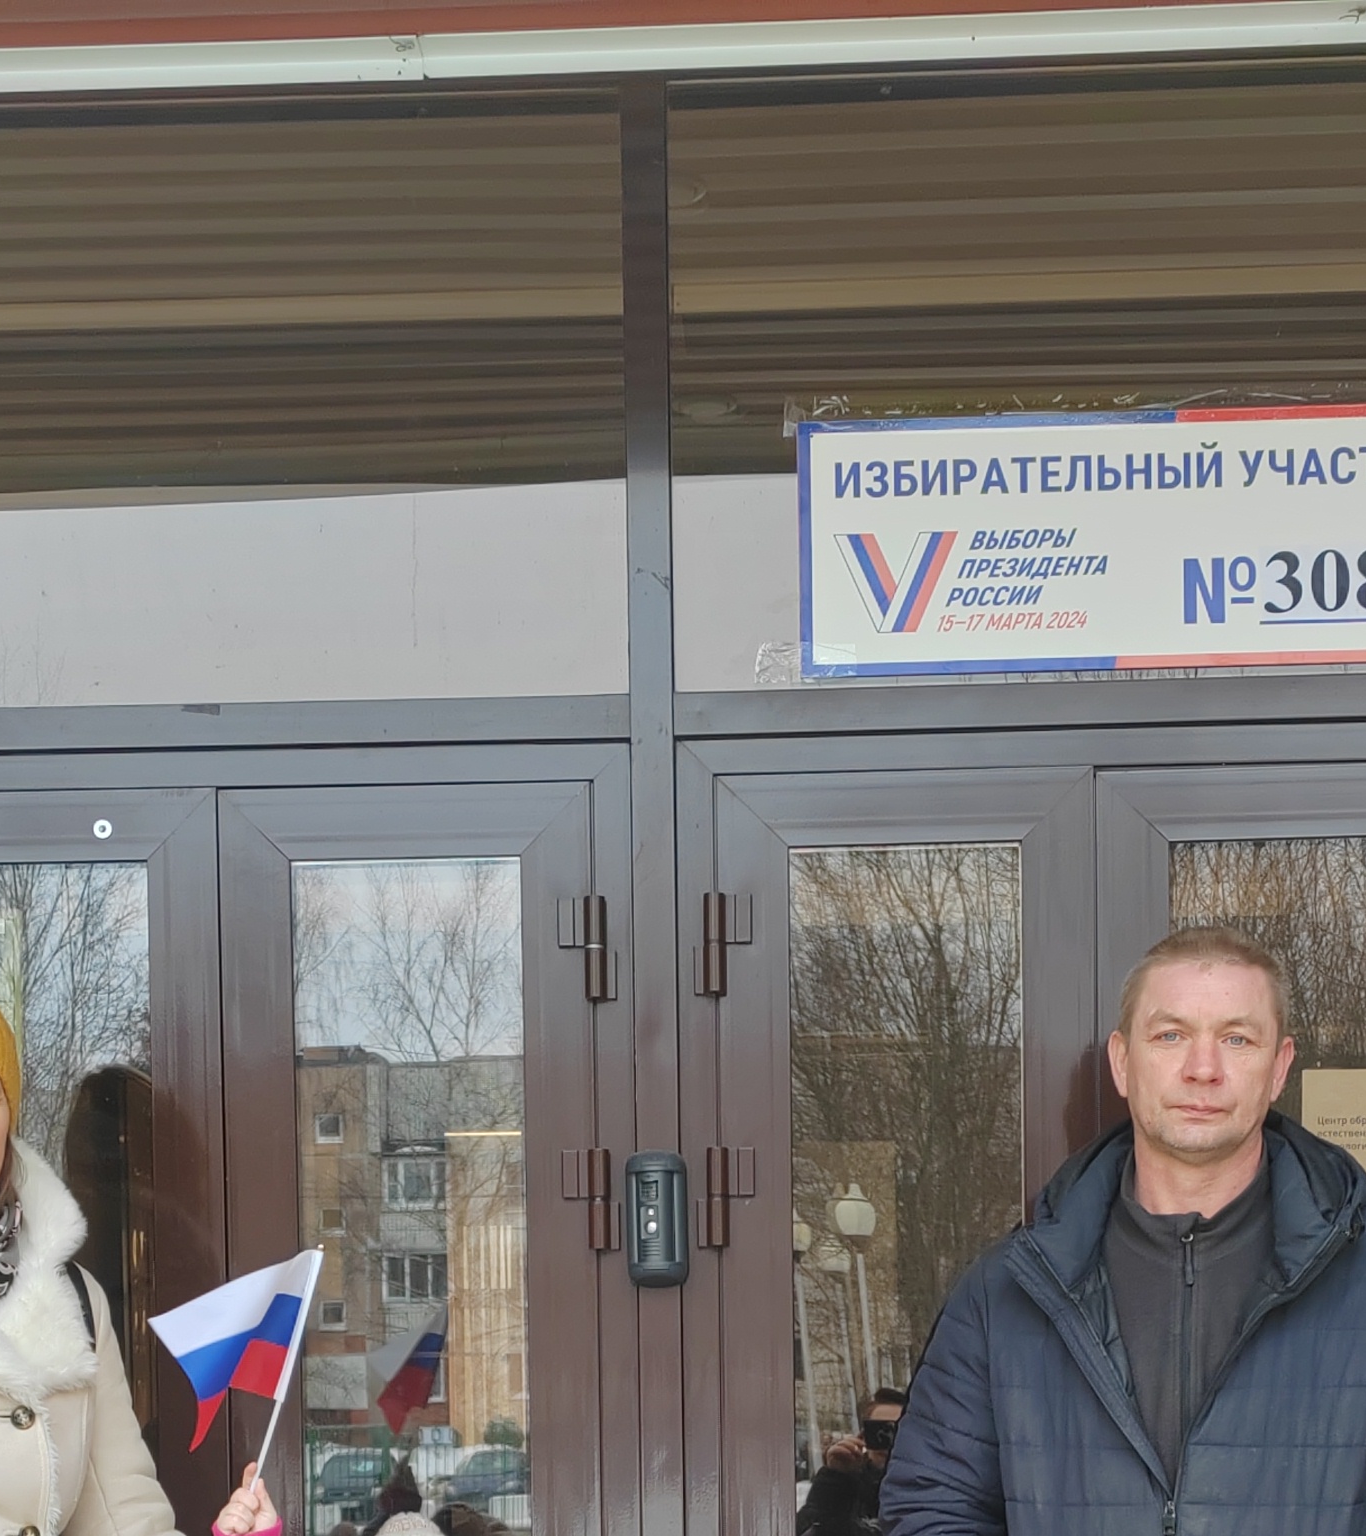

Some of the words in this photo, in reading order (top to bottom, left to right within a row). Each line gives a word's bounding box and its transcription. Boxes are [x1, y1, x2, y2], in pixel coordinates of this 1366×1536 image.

[834, 441, 1223, 499] ИЗБИРАТЕЛЬНЫЙ
[968, 527, 1078, 551] ВЫБОРЫ
[956, 554, 1109, 580] ПРЕЗИДЕНТА
[944, 584, 1045, 608] РОССИИ
[984, 611, 1044, 632] МАРТА
[1045, 610, 1089, 631] 2024
[1316, 1115, 1348, 1127] Центр
